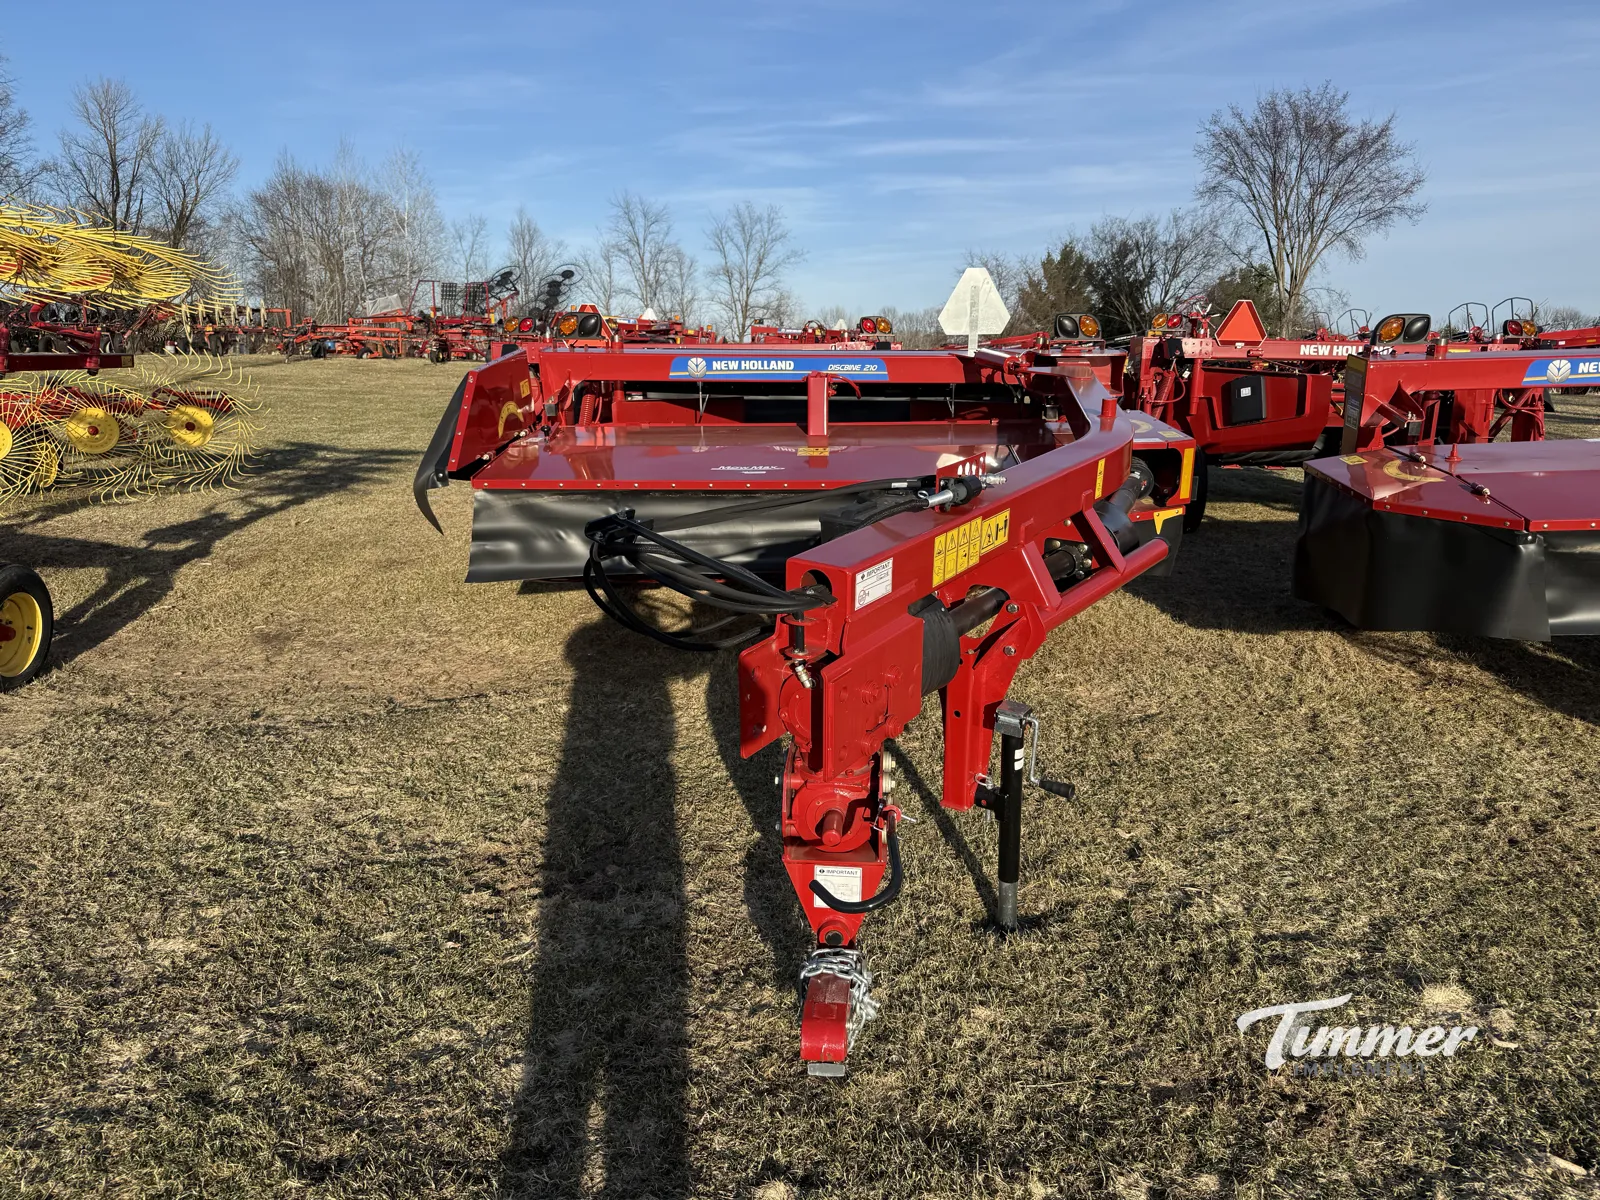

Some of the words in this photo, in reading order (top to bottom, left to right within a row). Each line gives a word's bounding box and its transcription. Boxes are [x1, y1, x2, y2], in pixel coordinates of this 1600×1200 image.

[1300, 344, 1331, 356] NEW
[1333, 345, 1393, 356] HOLLND
[712, 360, 739, 371] NEW
[741, 360, 794, 371] HOLLAND
[1578, 361, 1600, 373] NE
[866, 561, 890, 578] IMPORTANT
